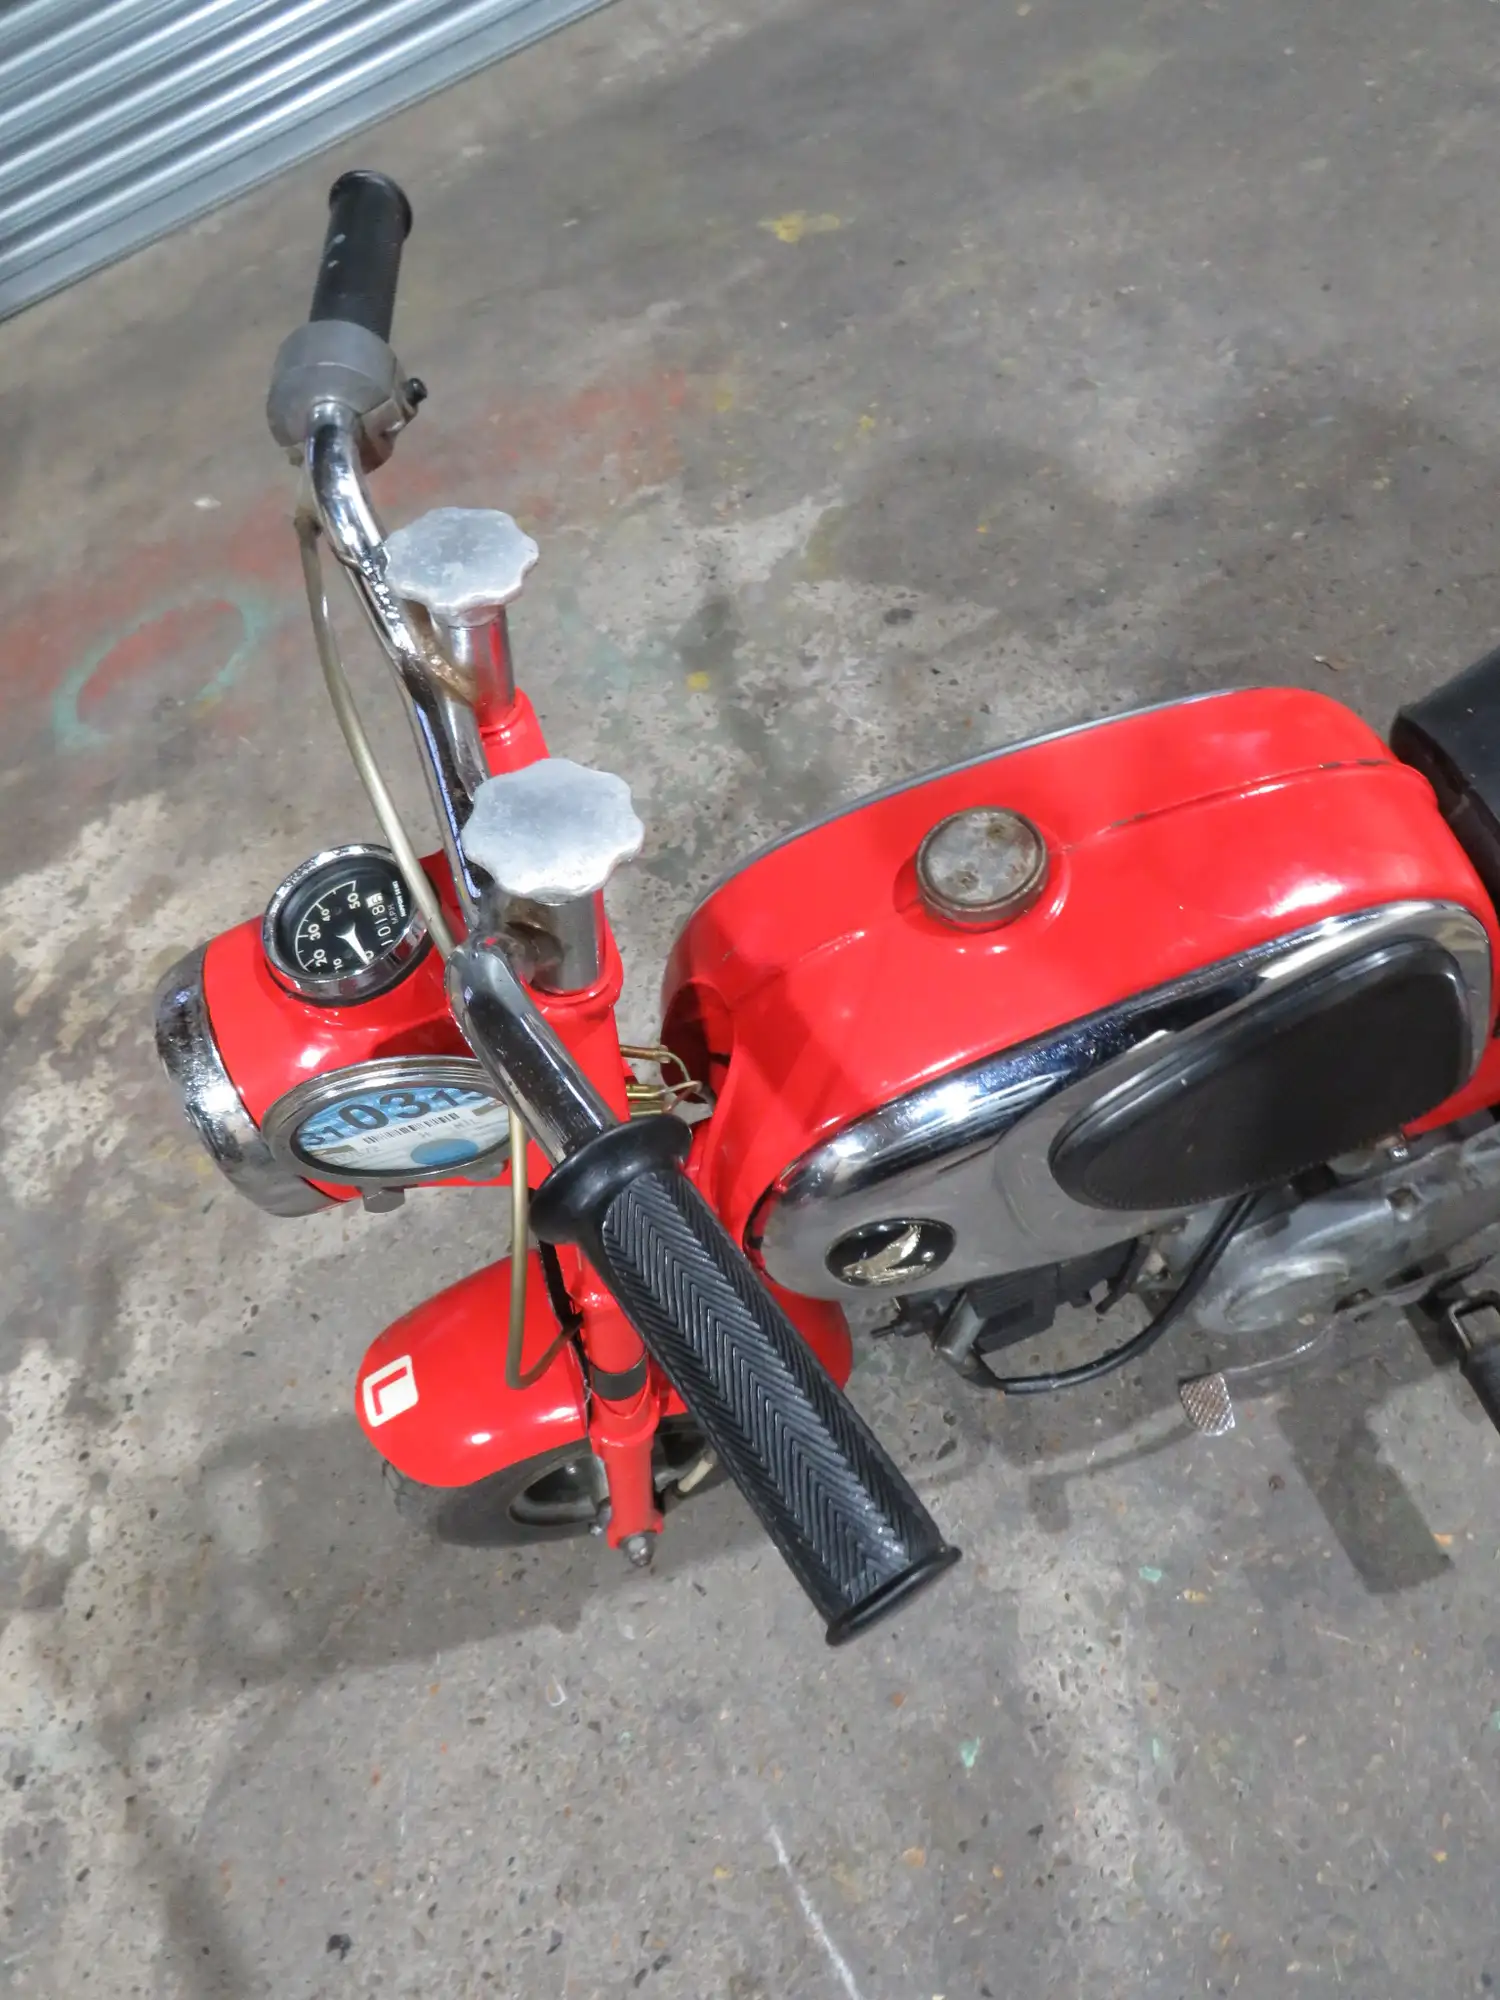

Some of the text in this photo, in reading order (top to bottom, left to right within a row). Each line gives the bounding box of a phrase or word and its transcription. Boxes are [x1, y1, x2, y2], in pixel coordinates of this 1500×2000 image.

[347, 893, 361, 909] 50
[321, 908, 331, 922] 40
[307, 923, 321, 941] 30
[313, 948, 328, 967] 20
[333, 958, 344, 970] 10
[300, 1125, 345, 1146] 31
[338, 1092, 432, 1130] 03
[371, 1365, 408, 1417] L
